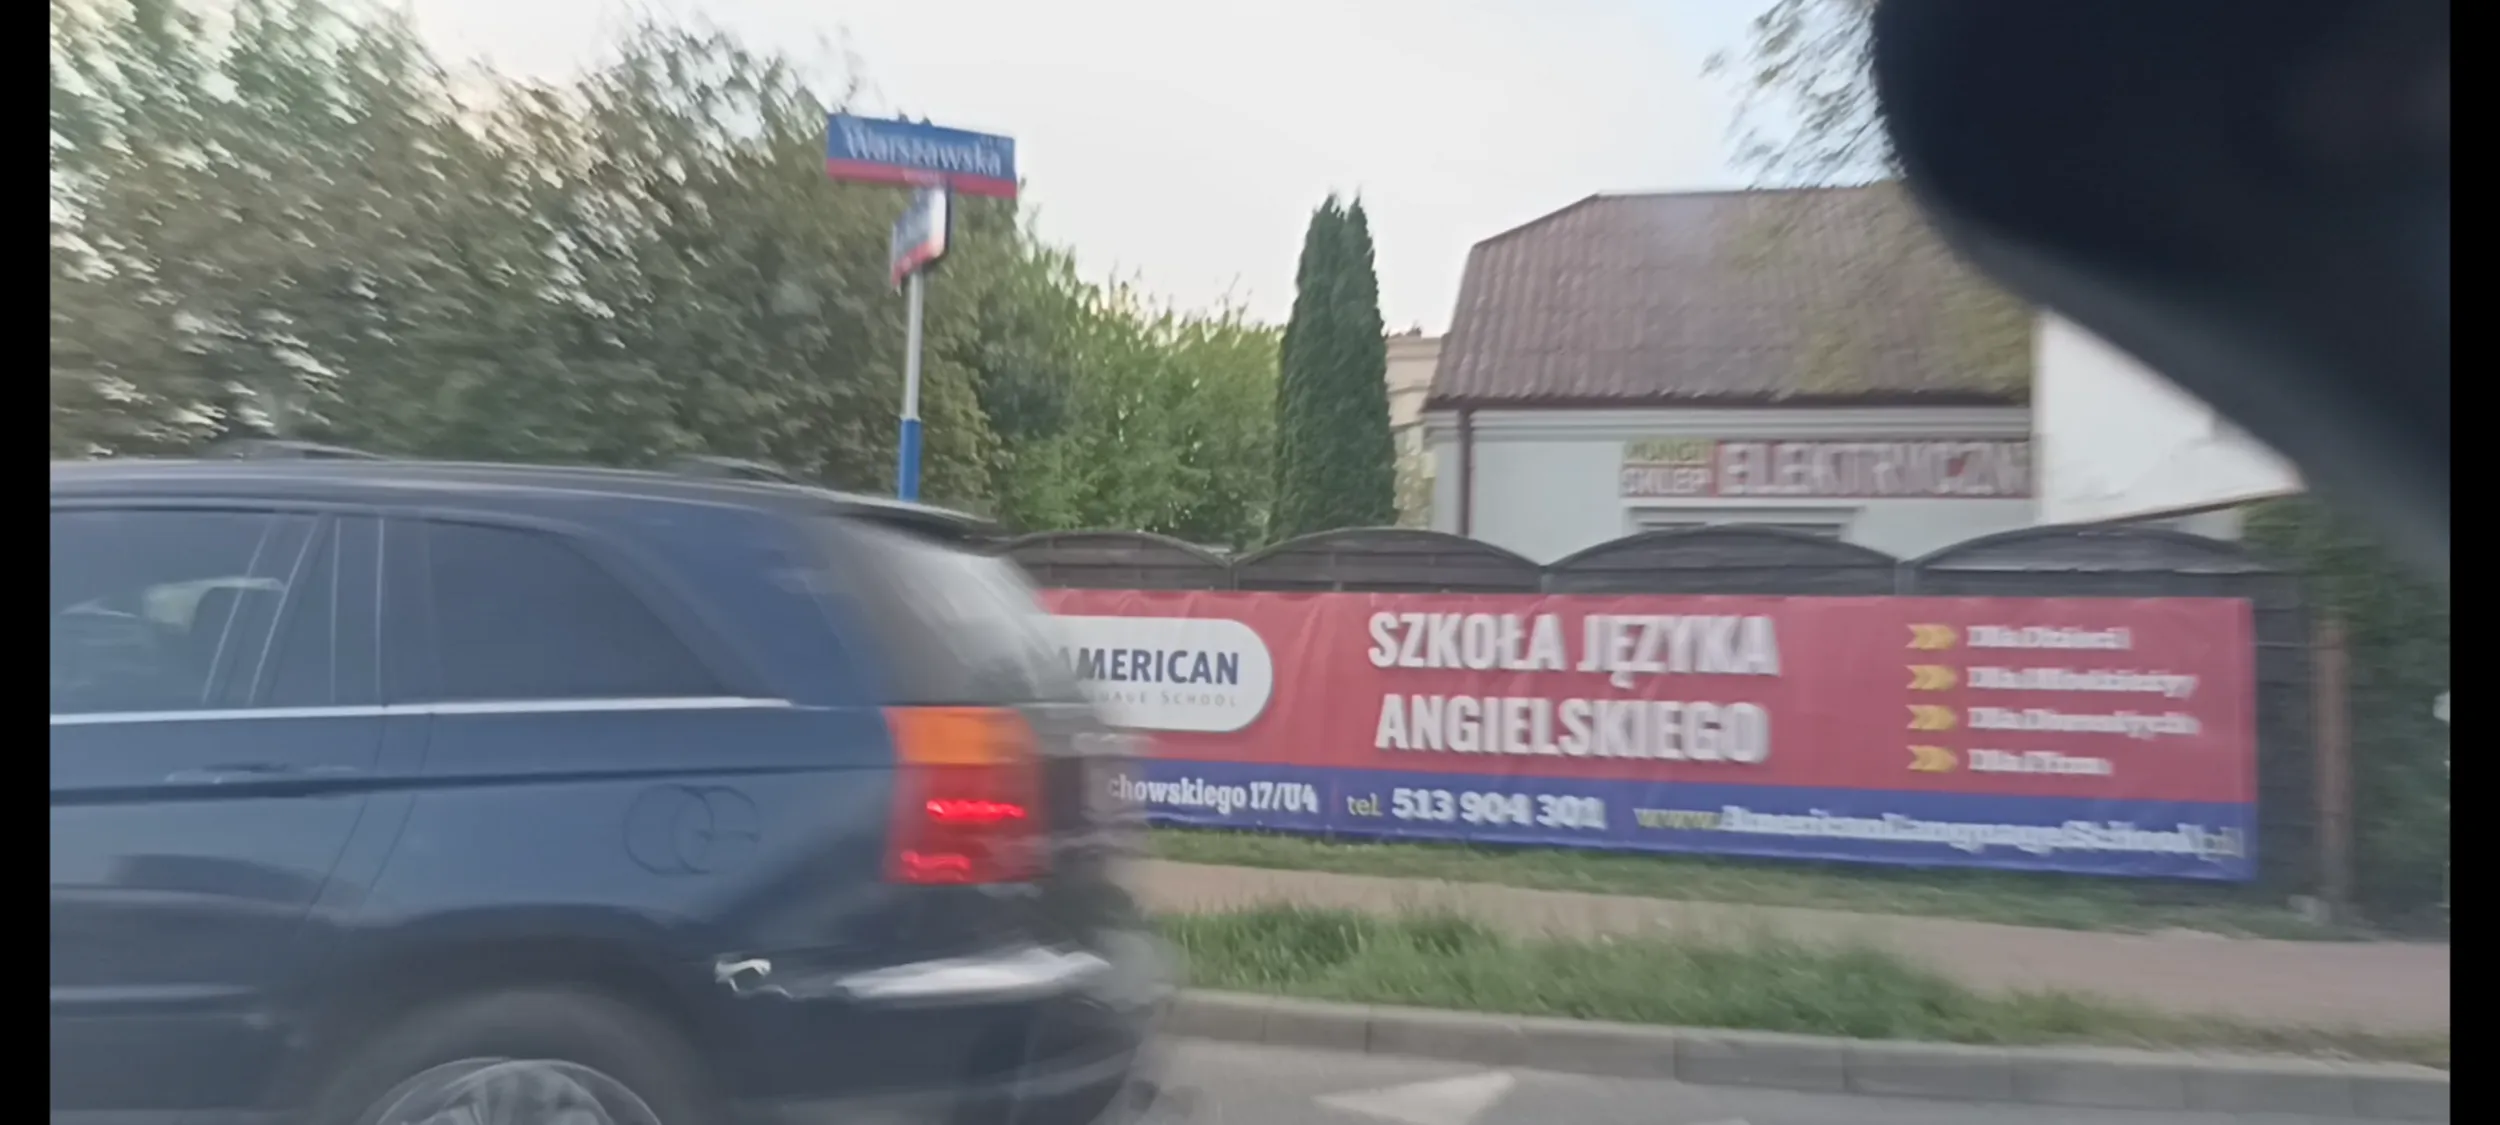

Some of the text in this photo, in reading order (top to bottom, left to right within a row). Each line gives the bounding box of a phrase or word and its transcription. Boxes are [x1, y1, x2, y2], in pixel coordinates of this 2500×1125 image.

[839, 121, 1002, 177] Warszawska
[1622, 467, 1713, 495] SKLEP
[1719, 442, 2036, 496] ELEKTRYCZN
[1368, 611, 1781, 689] SZKOŁA JĘZYKA
[1375, 693, 1772, 763] ANGIELSKIEGO
[1107, 774, 1248, 816] chowskiego
[1391, 787, 1455, 821] 513
[1460, 791, 1533, 826] 904
[1536, 794, 1607, 830] 301
